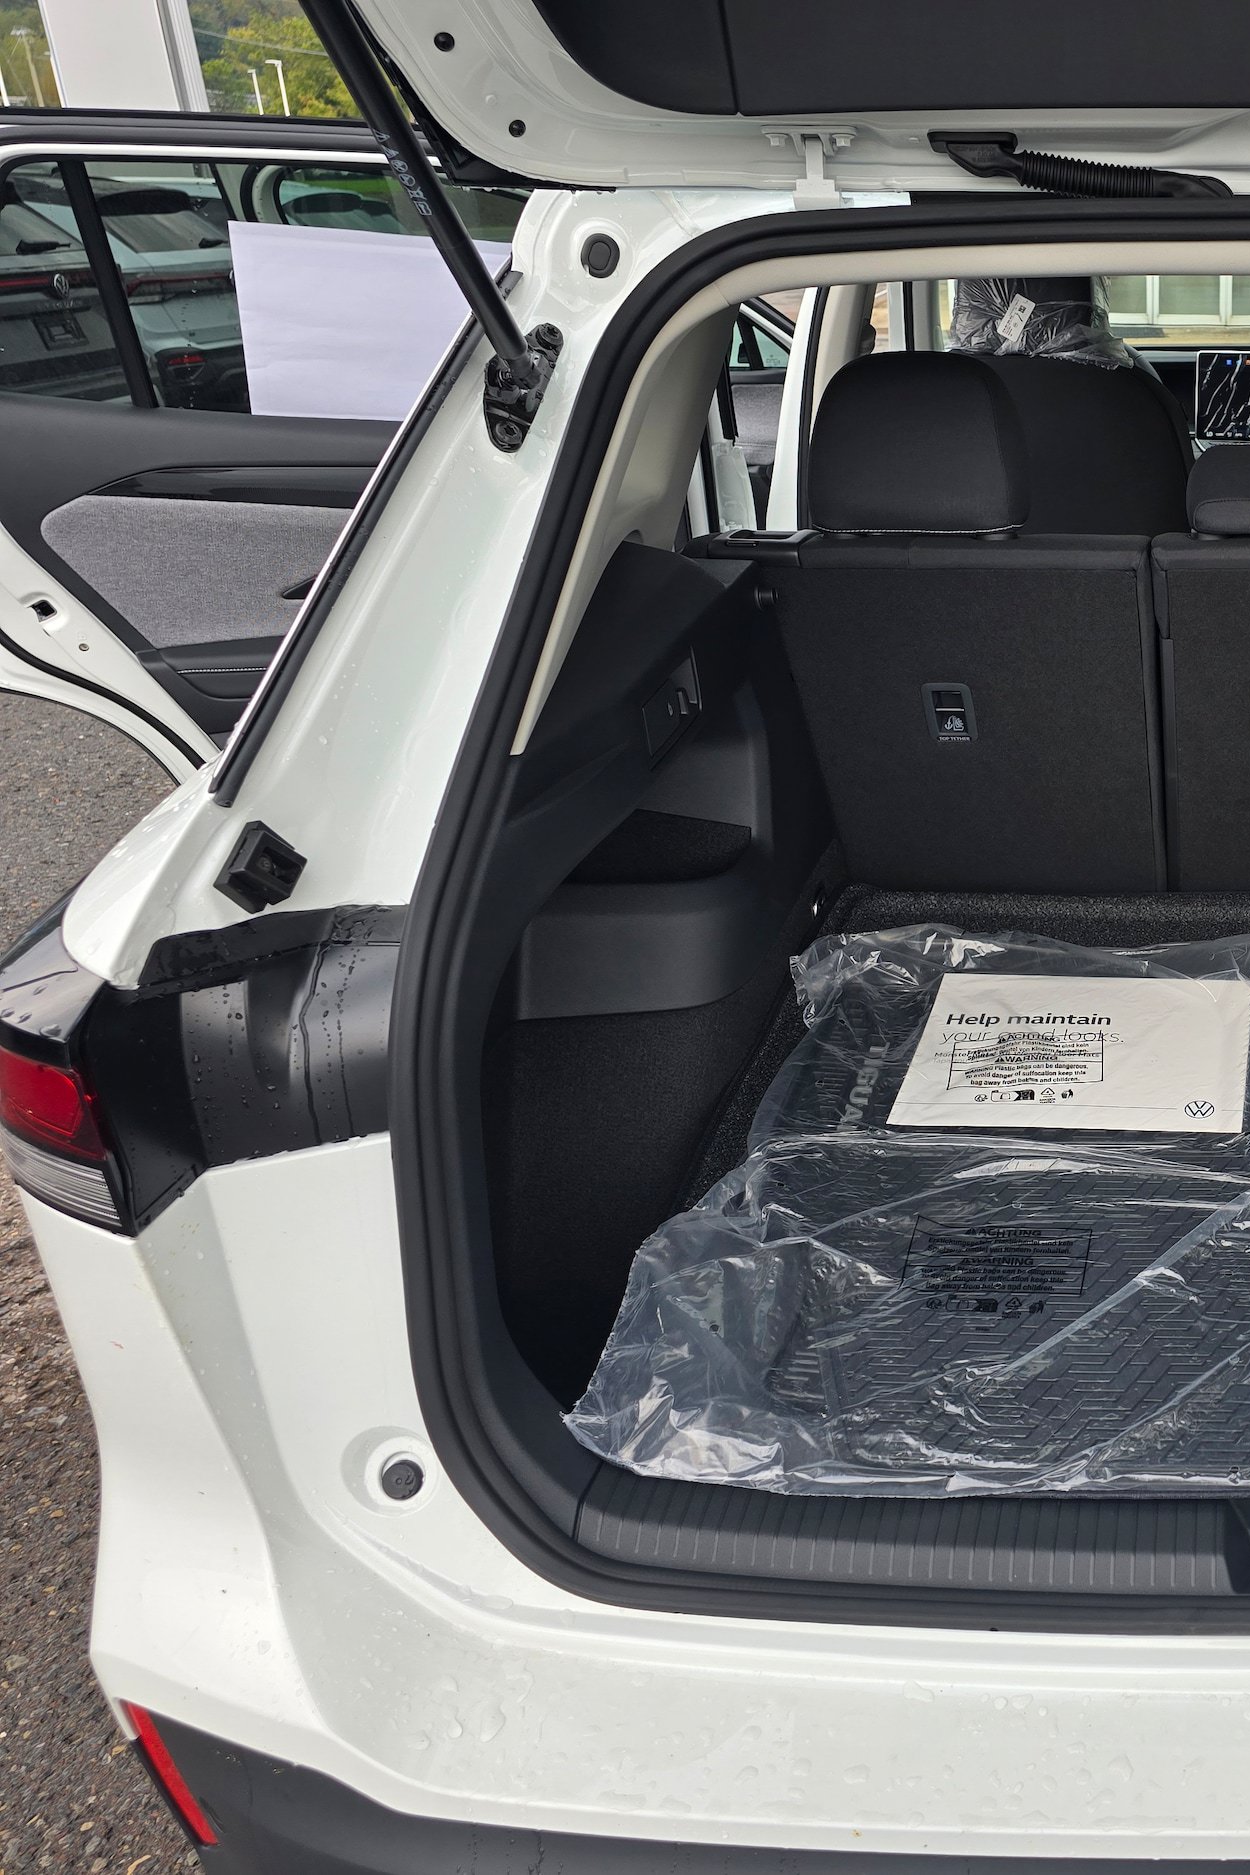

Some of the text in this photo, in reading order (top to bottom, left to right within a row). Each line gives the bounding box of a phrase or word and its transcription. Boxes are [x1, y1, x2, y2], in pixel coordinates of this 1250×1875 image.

[946, 1012, 1111, 1027] Help maintain
[939, 1031, 992, 1046] your
[1063, 1028, 1124, 1043] looks.
[1004, 1053, 1058, 1063] WARNING
[991, 1072, 1014, 1080] danger
[975, 1227, 1042, 1238] ACHTUNG
[971, 1257, 1034, 1266] WARNING
